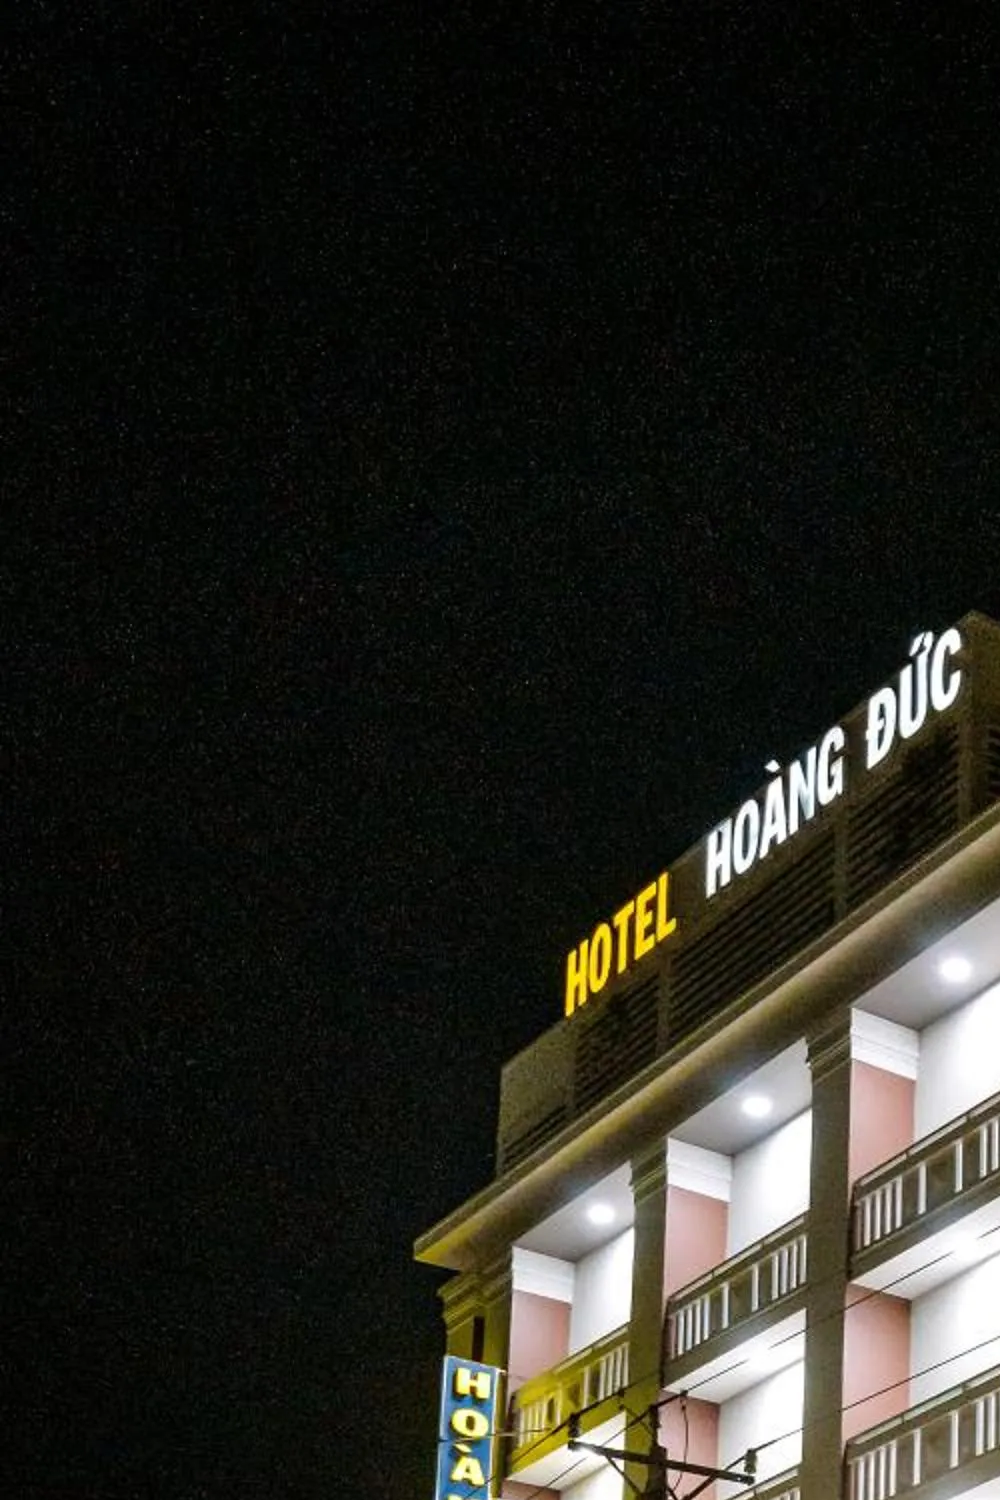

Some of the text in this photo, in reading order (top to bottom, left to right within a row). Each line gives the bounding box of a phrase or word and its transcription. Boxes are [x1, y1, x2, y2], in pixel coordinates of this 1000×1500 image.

[564, 627, 963, 1018] HOTEL HOÀNG ĐỨC
